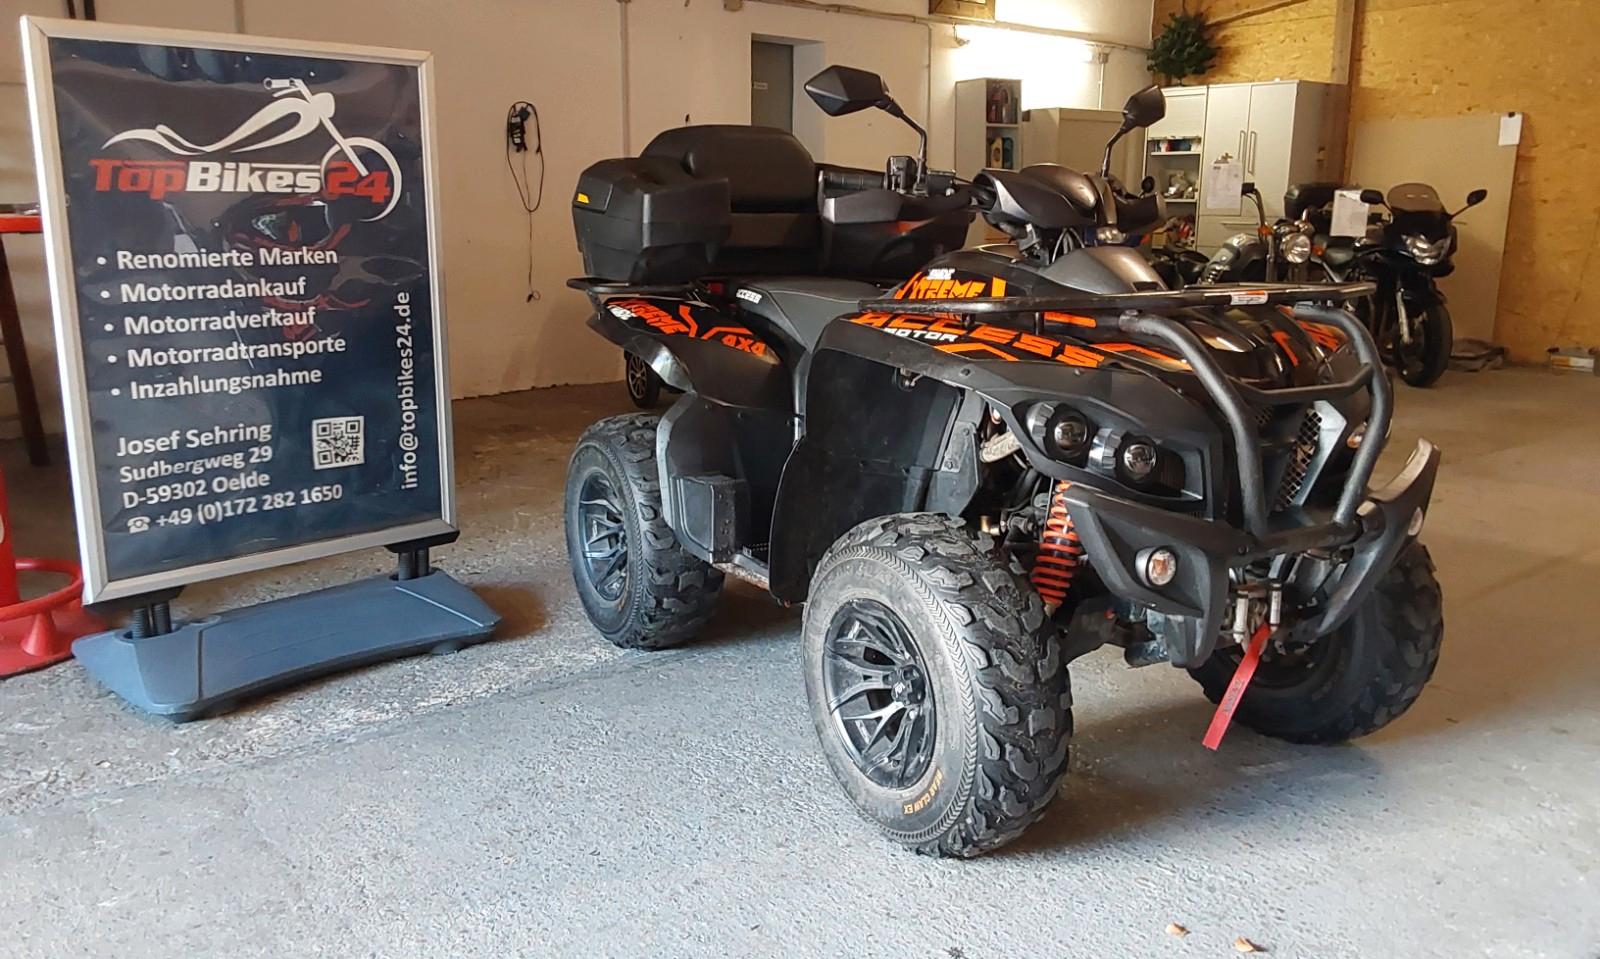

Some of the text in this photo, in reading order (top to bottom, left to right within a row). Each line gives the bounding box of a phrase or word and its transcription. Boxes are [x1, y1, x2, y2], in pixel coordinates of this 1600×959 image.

[117, 247, 338, 270] Renomierte Marken
[121, 277, 306, 303] Motorradankauf
[124, 307, 316, 335] Motorradverkauf
[884, 327, 959, 342] MOTOR
[127, 336, 346, 368] Motorradtransporte
[850, 311, 1105, 368] ACCESS
[130, 367, 322, 400] Inzahlungsnahme
[394, 291, 418, 489] info@topbikes24.de
[117, 422, 272, 457] Josef Sehring
[120, 446, 273, 483] Sudbergweg 29
[122, 471, 271, 509] D-59302 Oelde
[155, 484, 343, 528] +49 (0)172 282 1650
